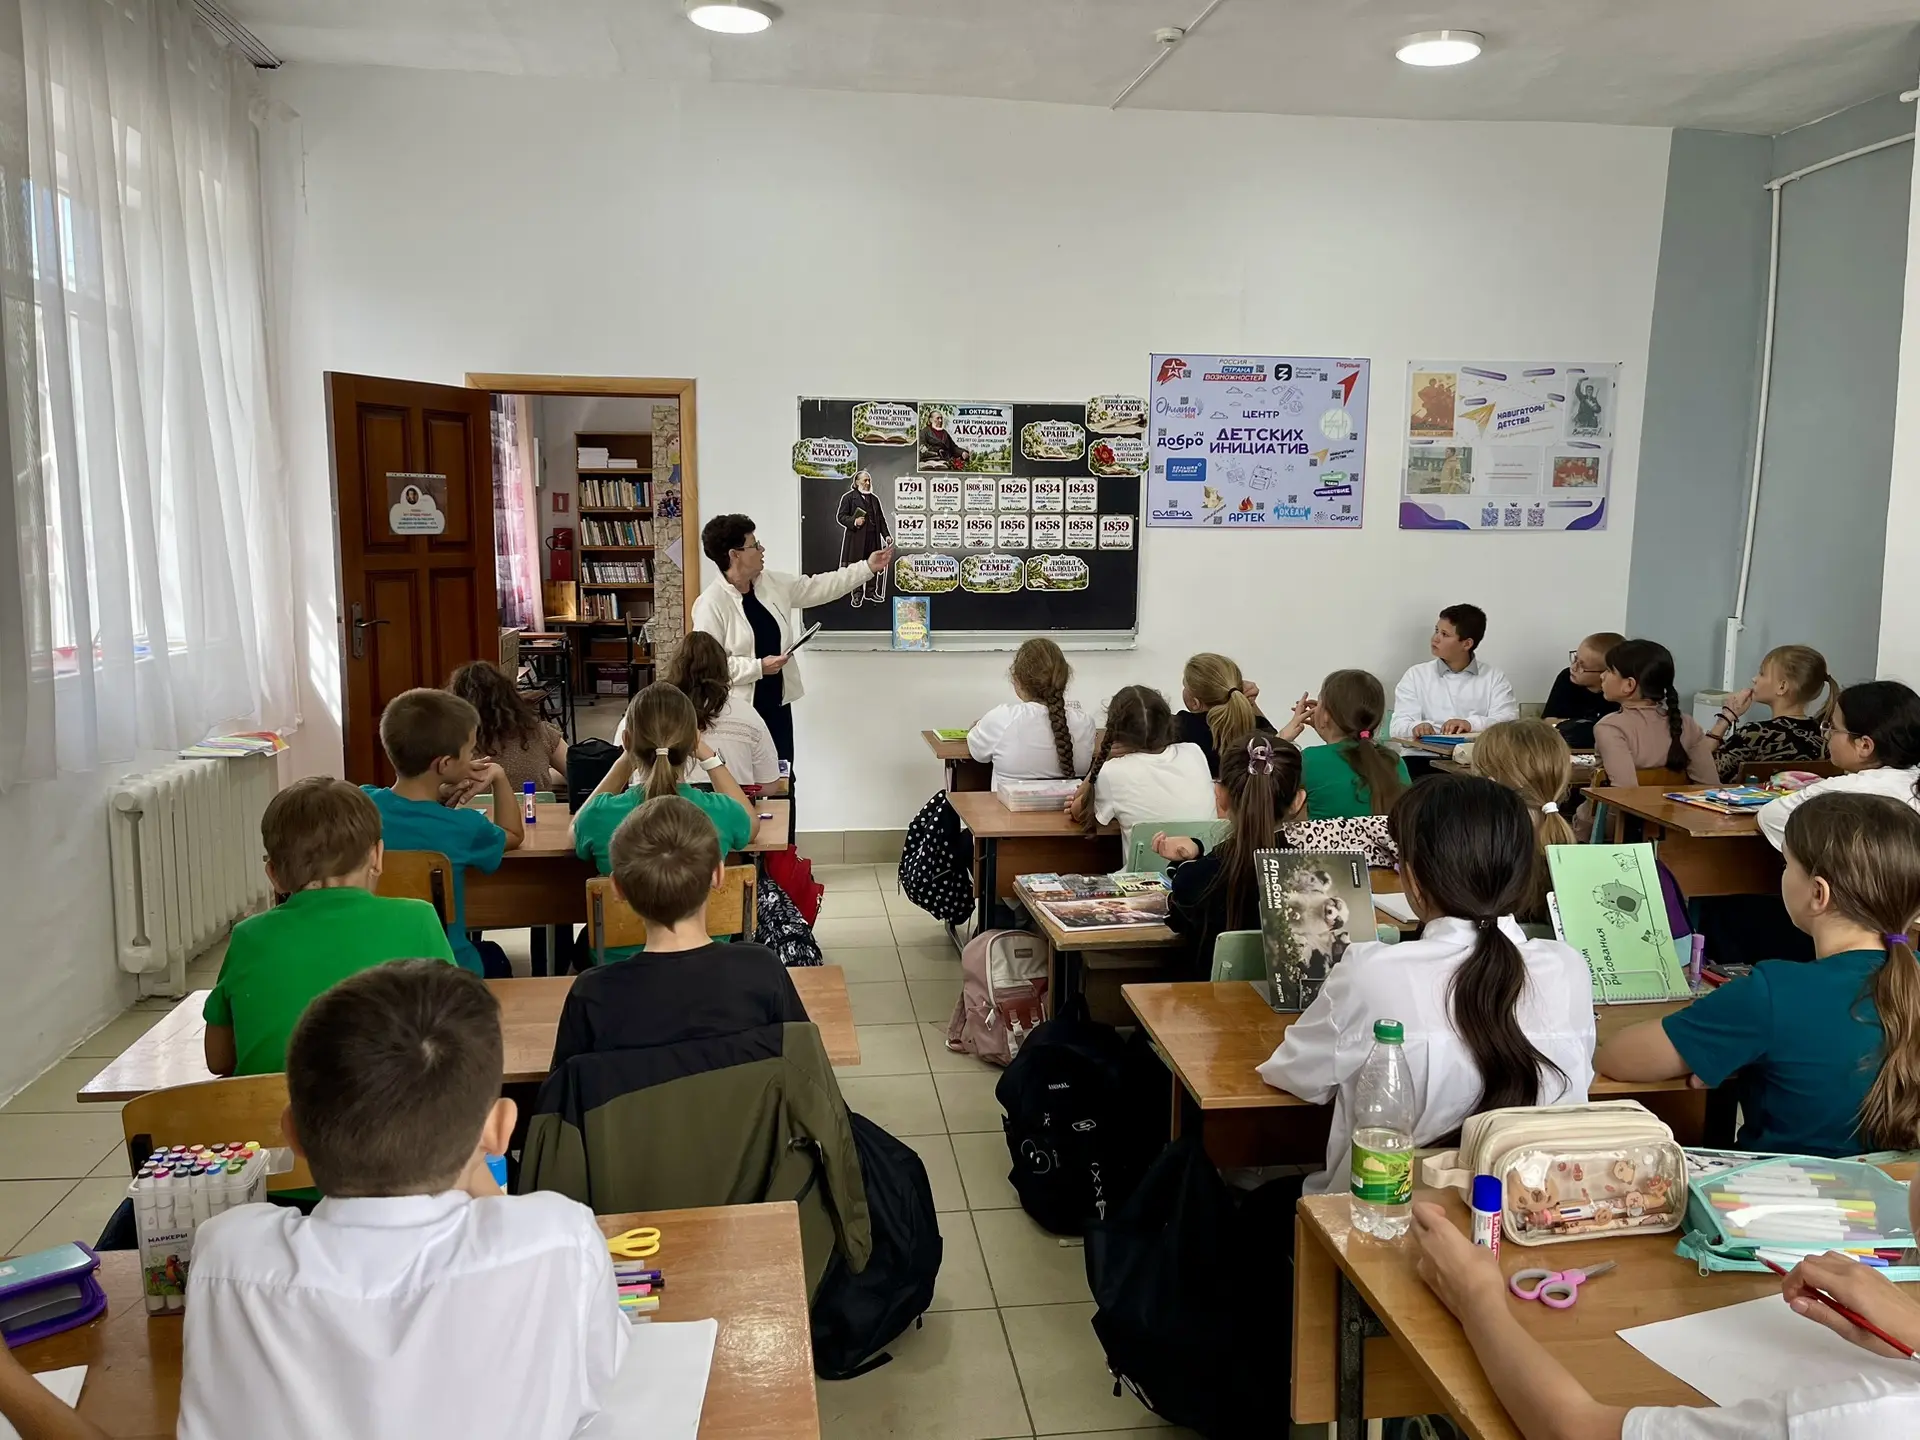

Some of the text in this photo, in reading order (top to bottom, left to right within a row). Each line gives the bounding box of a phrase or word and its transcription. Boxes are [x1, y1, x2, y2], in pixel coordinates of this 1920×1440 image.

[1242, 410, 1280, 420] ЦЕНТР
[1497, 404, 1545, 420] НАВИГАТОРЫ
[1497, 416, 1530, 430] ДЕТСТВА
[954, 425, 1007, 435] АКСАКОВ
[1216, 428, 1304, 441] ДЕТСКИХ
[1157, 434, 1204, 448] добро
[812, 448, 852, 457] КРАСОТУ
[1210, 443, 1309, 454] ИНИЦИАТИВ
[899, 482, 922, 492] 1791
[932, 483, 959, 493] 1805
[1000, 484, 1026, 493] 1826
[1035, 484, 1060, 493] 1834
[1068, 484, 1094, 493] 1843
[1279, 507, 1306, 516] ОКЕАН
[1228, 513, 1265, 522] АРТЕК
[898, 520, 924, 529] 1847
[933, 520, 958, 529] 1852
[966, 520, 992, 529] 1856
[1000, 520, 1025, 530] 1856
[1035, 520, 1060, 530] 1858
[1068, 520, 1093, 530] 1858
[1103, 521, 1129, 531] 1859
[1269, 859, 1282, 909] Альбом
[1264, 871, 1272, 909] рисования
[1596, 928, 1622, 985] рисования
[1275, 972, 1281, 983] 24
[148, 1233, 187, 1242] МАРКЕРЫ
